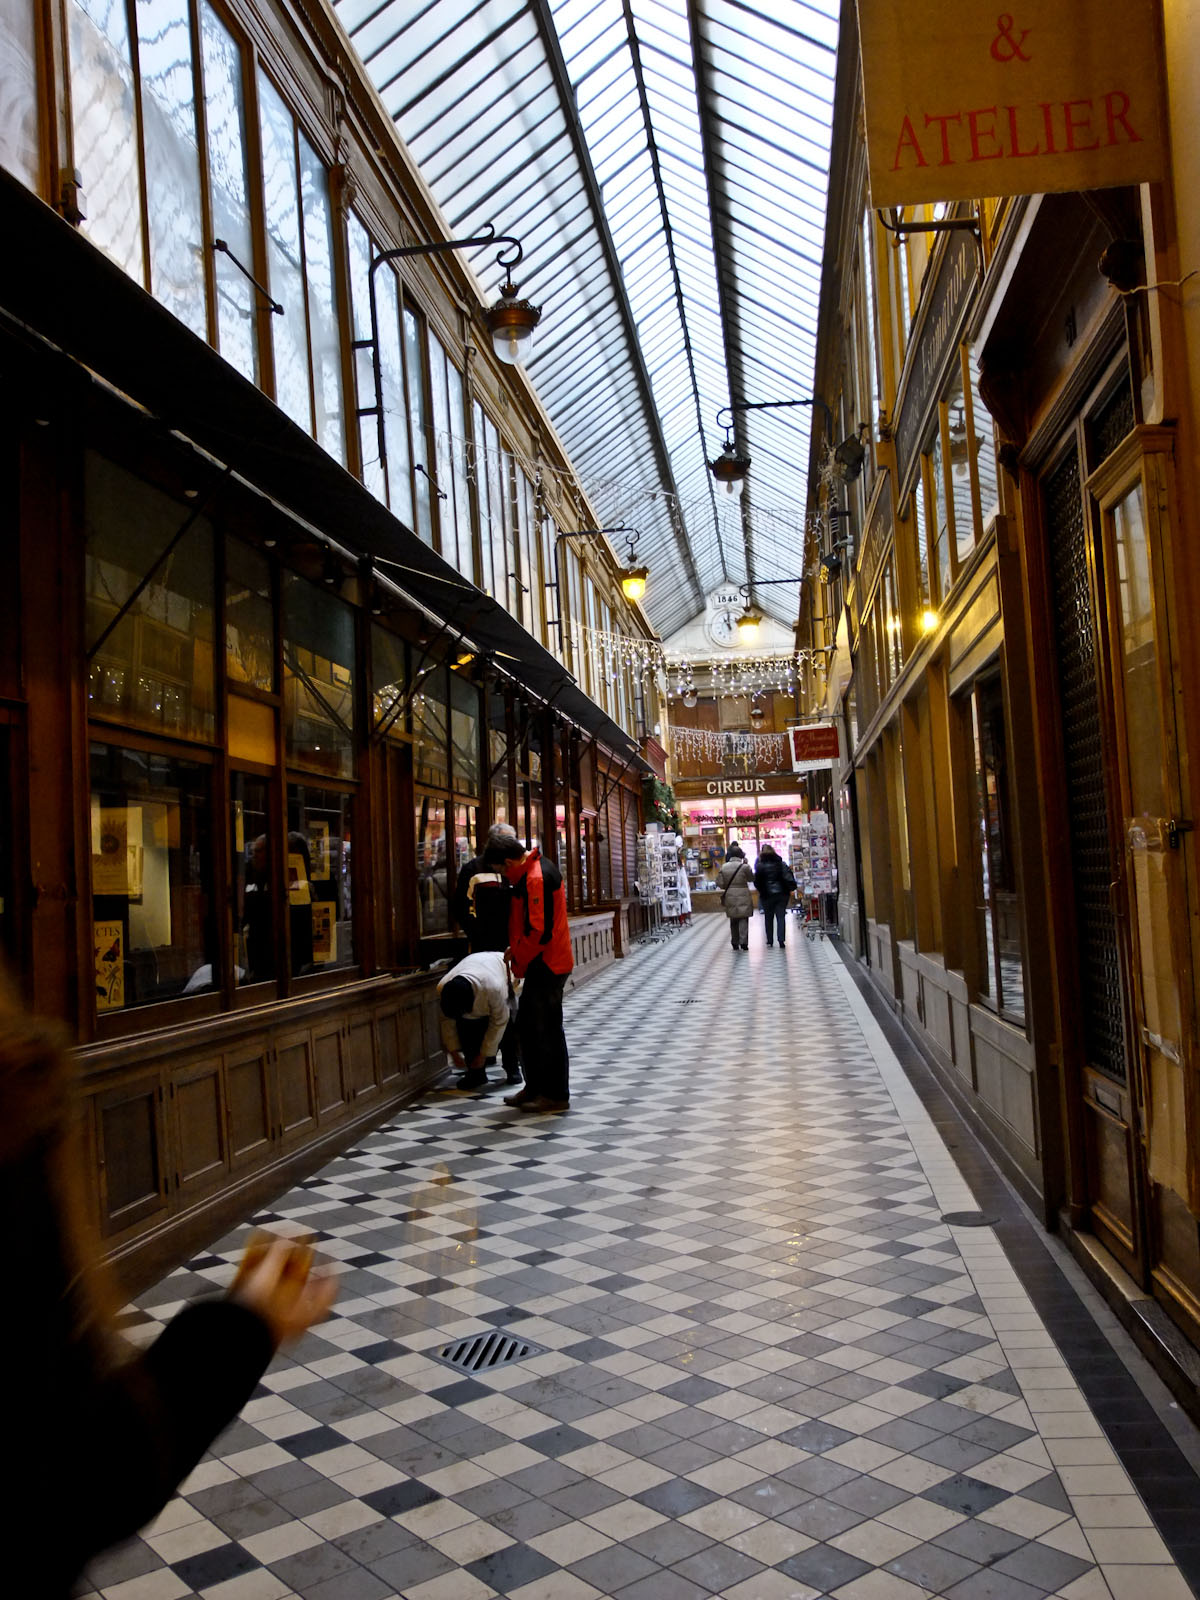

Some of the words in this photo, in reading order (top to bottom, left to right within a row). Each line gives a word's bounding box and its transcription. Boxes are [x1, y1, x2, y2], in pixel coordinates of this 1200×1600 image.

[990, 12, 1033, 62] &
[889, 90, 1144, 172] ATELIER
[718, 595, 738, 603] 1846
[706, 779, 766, 794] CIREUR
[95, 927, 120, 937] CTES
